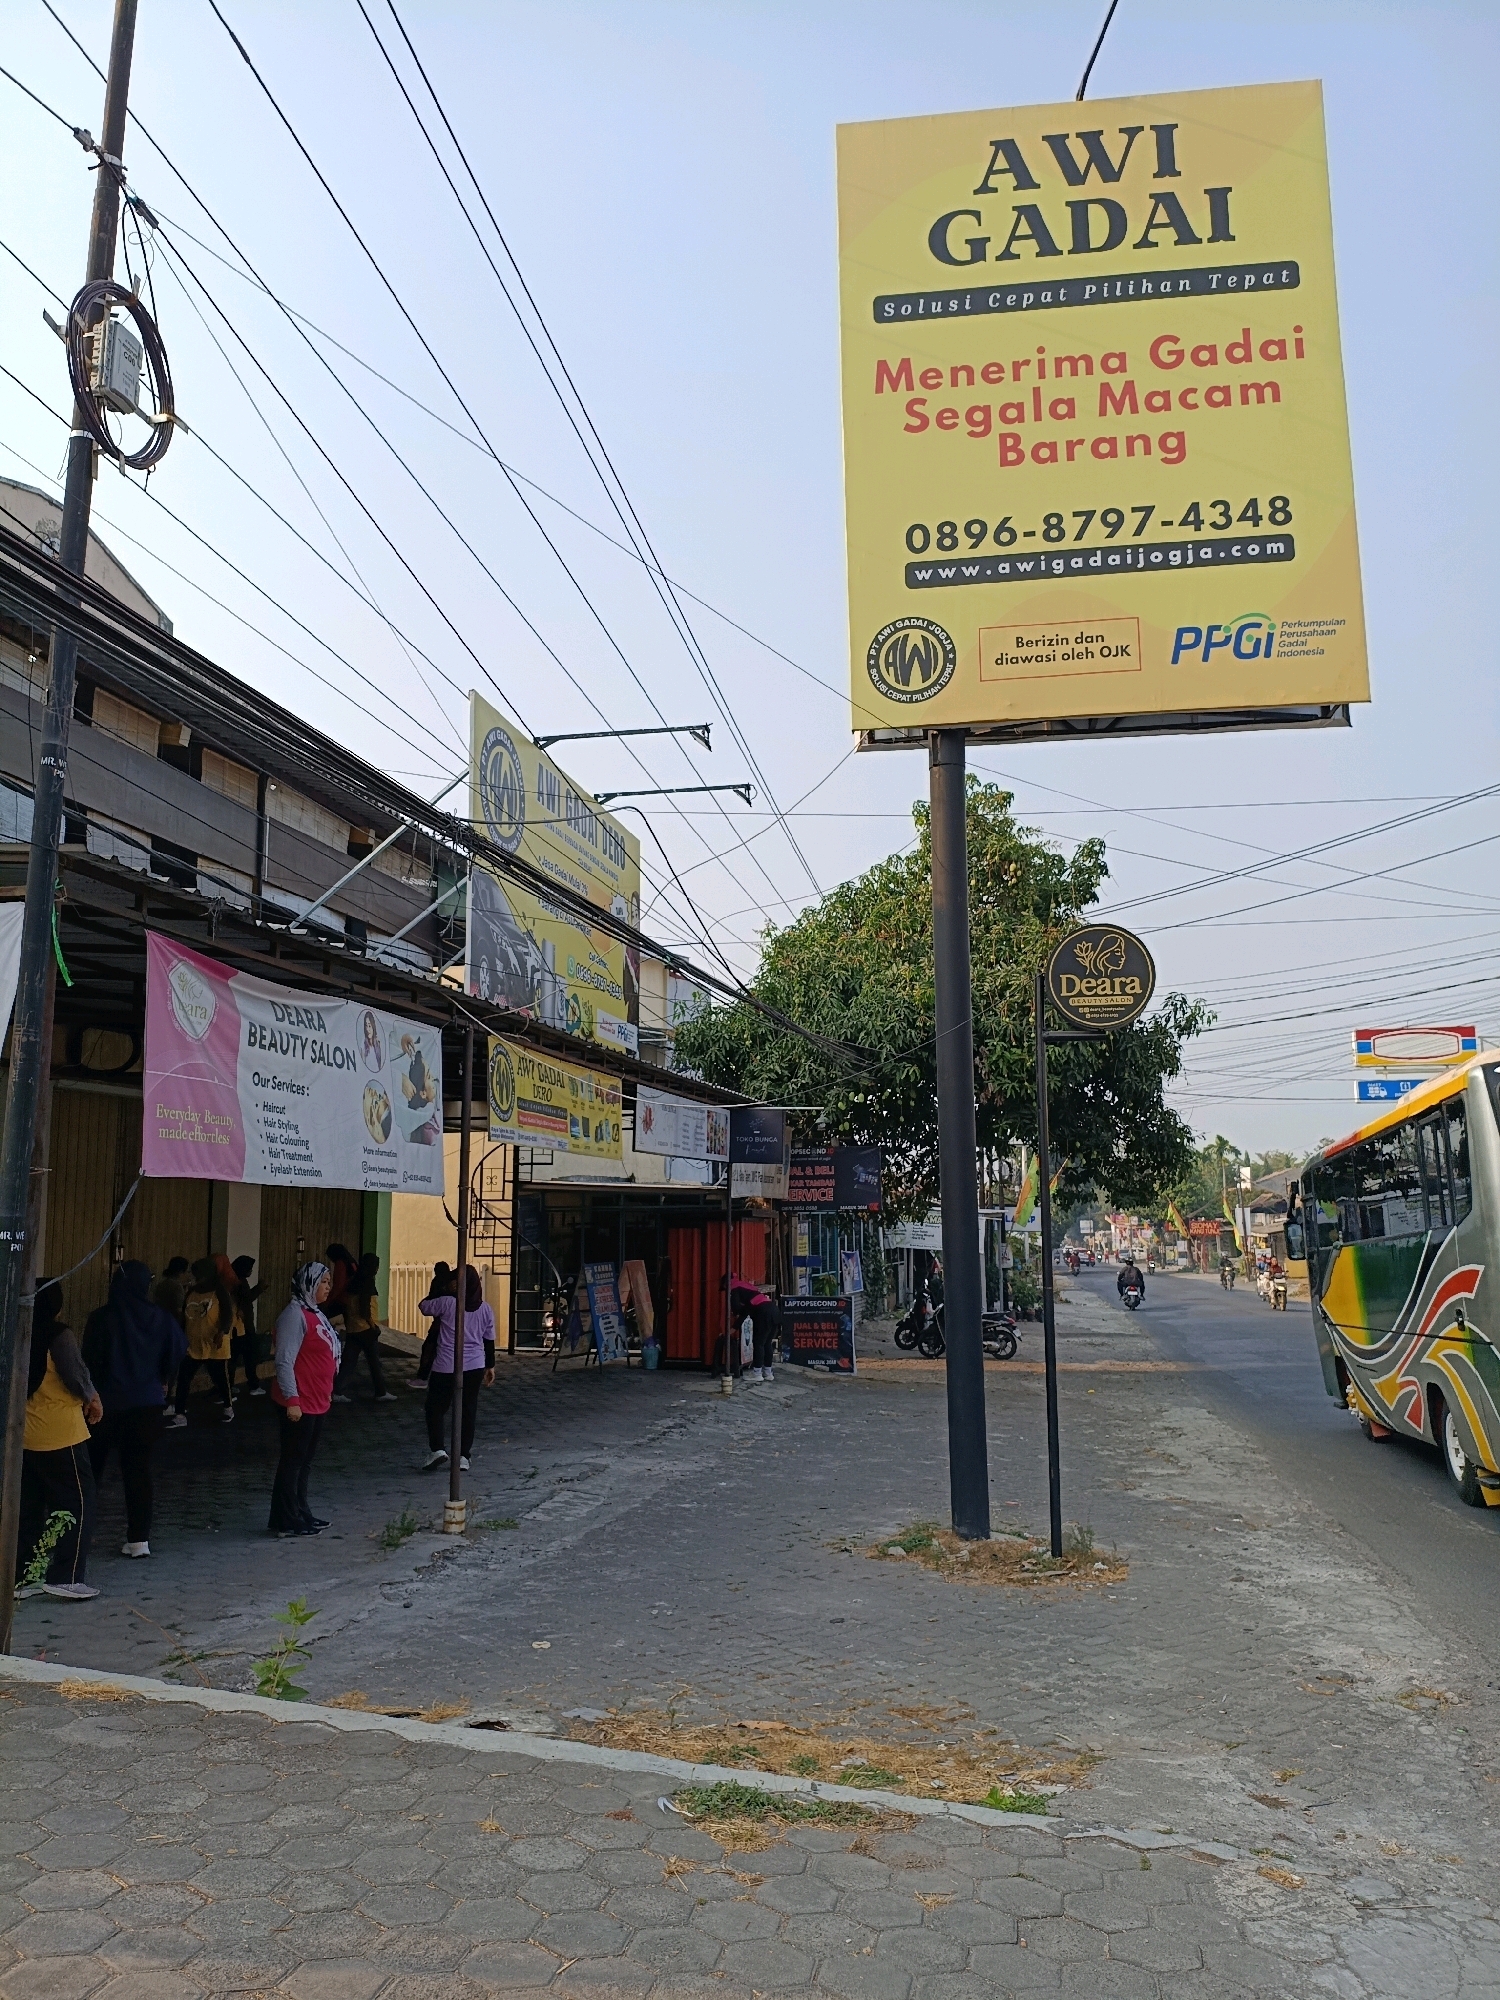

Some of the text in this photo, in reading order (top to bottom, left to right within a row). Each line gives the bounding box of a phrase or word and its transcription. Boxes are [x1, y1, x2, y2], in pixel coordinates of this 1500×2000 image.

[973, 123, 1181, 195] AWI
[927, 186, 1236, 266] GADAI
[883, 268, 1292, 318] Solusi Cepat Pilihan Tepat
[874, 324, 1306, 394] Menerima Gadai
[903, 379, 1282, 438] Segala Macam
[998, 429, 1187, 468] Barang
[905, 495, 1293, 554] 0896-8797-4348
[914, 539, 1286, 582] www.awigadaijogja.com
[1280, 628, 1337, 639] Perusahaan
[1281, 618, 1346, 630] Perkumpulan
[870, 619, 953, 655] PT AWI GADAI JOGJA
[1015, 630, 1106, 650] Berizin dan
[1278, 639, 1307, 648] Gadai
[994, 644, 1132, 667] diawasi oleh OJK
[1277, 647, 1325, 658] Indonesia
[870, 663, 954, 701] SOLUSI CEPAT PILIHAN TEPAT
[538, 762, 560, 818] AWI
[566, 788, 598, 848] GADAI
[602, 819, 626, 871] DERO
[541, 856, 553, 872] Jasa
[555, 864, 569, 882] Gadai
[1060, 974, 1142, 996] Deara
[269, 1000, 327, 1034] DEARA
[248, 1022, 357, 1073] BEAUTY SALON
[252, 1071, 270, 1090] Our
[517, 1056, 534, 1080] AWI
[538, 1063, 565, 1089] GADAI
[533, 1084, 552, 1102] DERO
[156, 1103, 200, 1128] Everyday
[263, 1101, 286, 1115] Haircut
[159, 1126, 230, 1145] made effortless
[264, 1117, 299, 1134] Hair Styling
[266, 1132, 309, 1150] Hair Colouring
[269, 1147, 314, 1162] Hair Treatment
[270, 1163, 322, 1177] Eyelash Extension
[815, 1166, 835, 1175] BELI
[787, 1188, 834, 1202] ERVICE
[793, 1322, 838, 1331] JUAL & BELI
[793, 1338, 839, 1349] SERVICE
